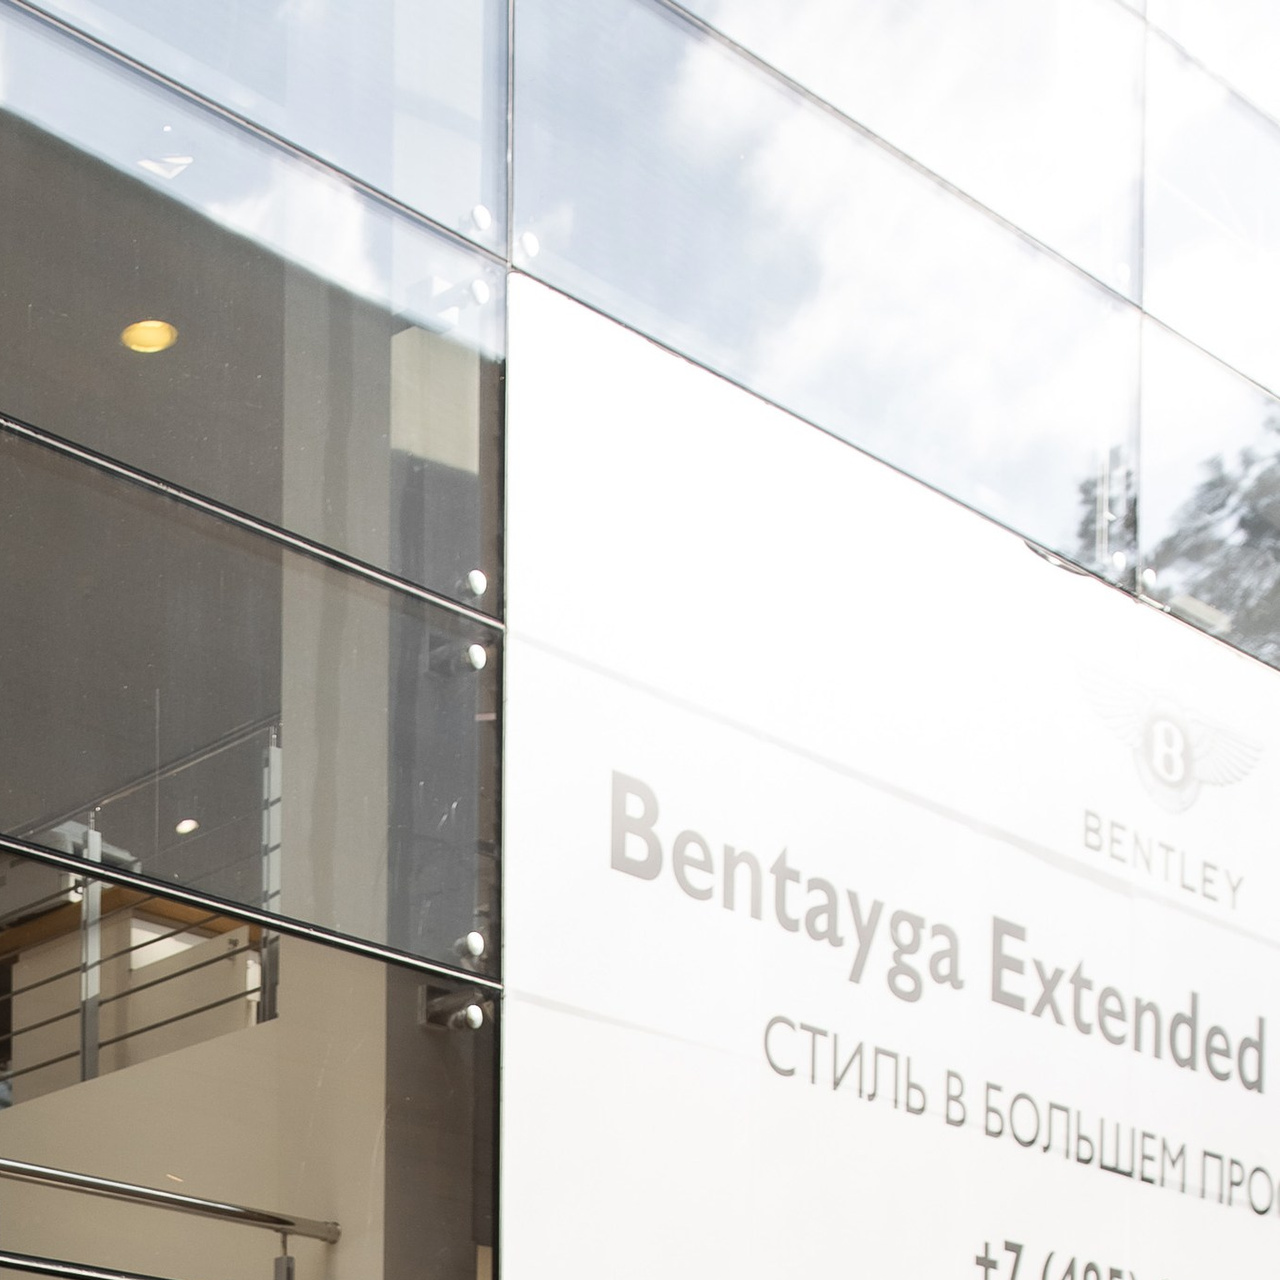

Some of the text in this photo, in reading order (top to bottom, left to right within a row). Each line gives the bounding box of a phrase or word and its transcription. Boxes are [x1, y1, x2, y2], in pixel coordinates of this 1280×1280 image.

[610, 769, 1266, 1095] Bentayga Extended
[1083, 808, 1244, 911] BENTLEY
[763, 1015, 1280, 1218] СТИЛЬ В БОЛЬШЕМ ПРО
